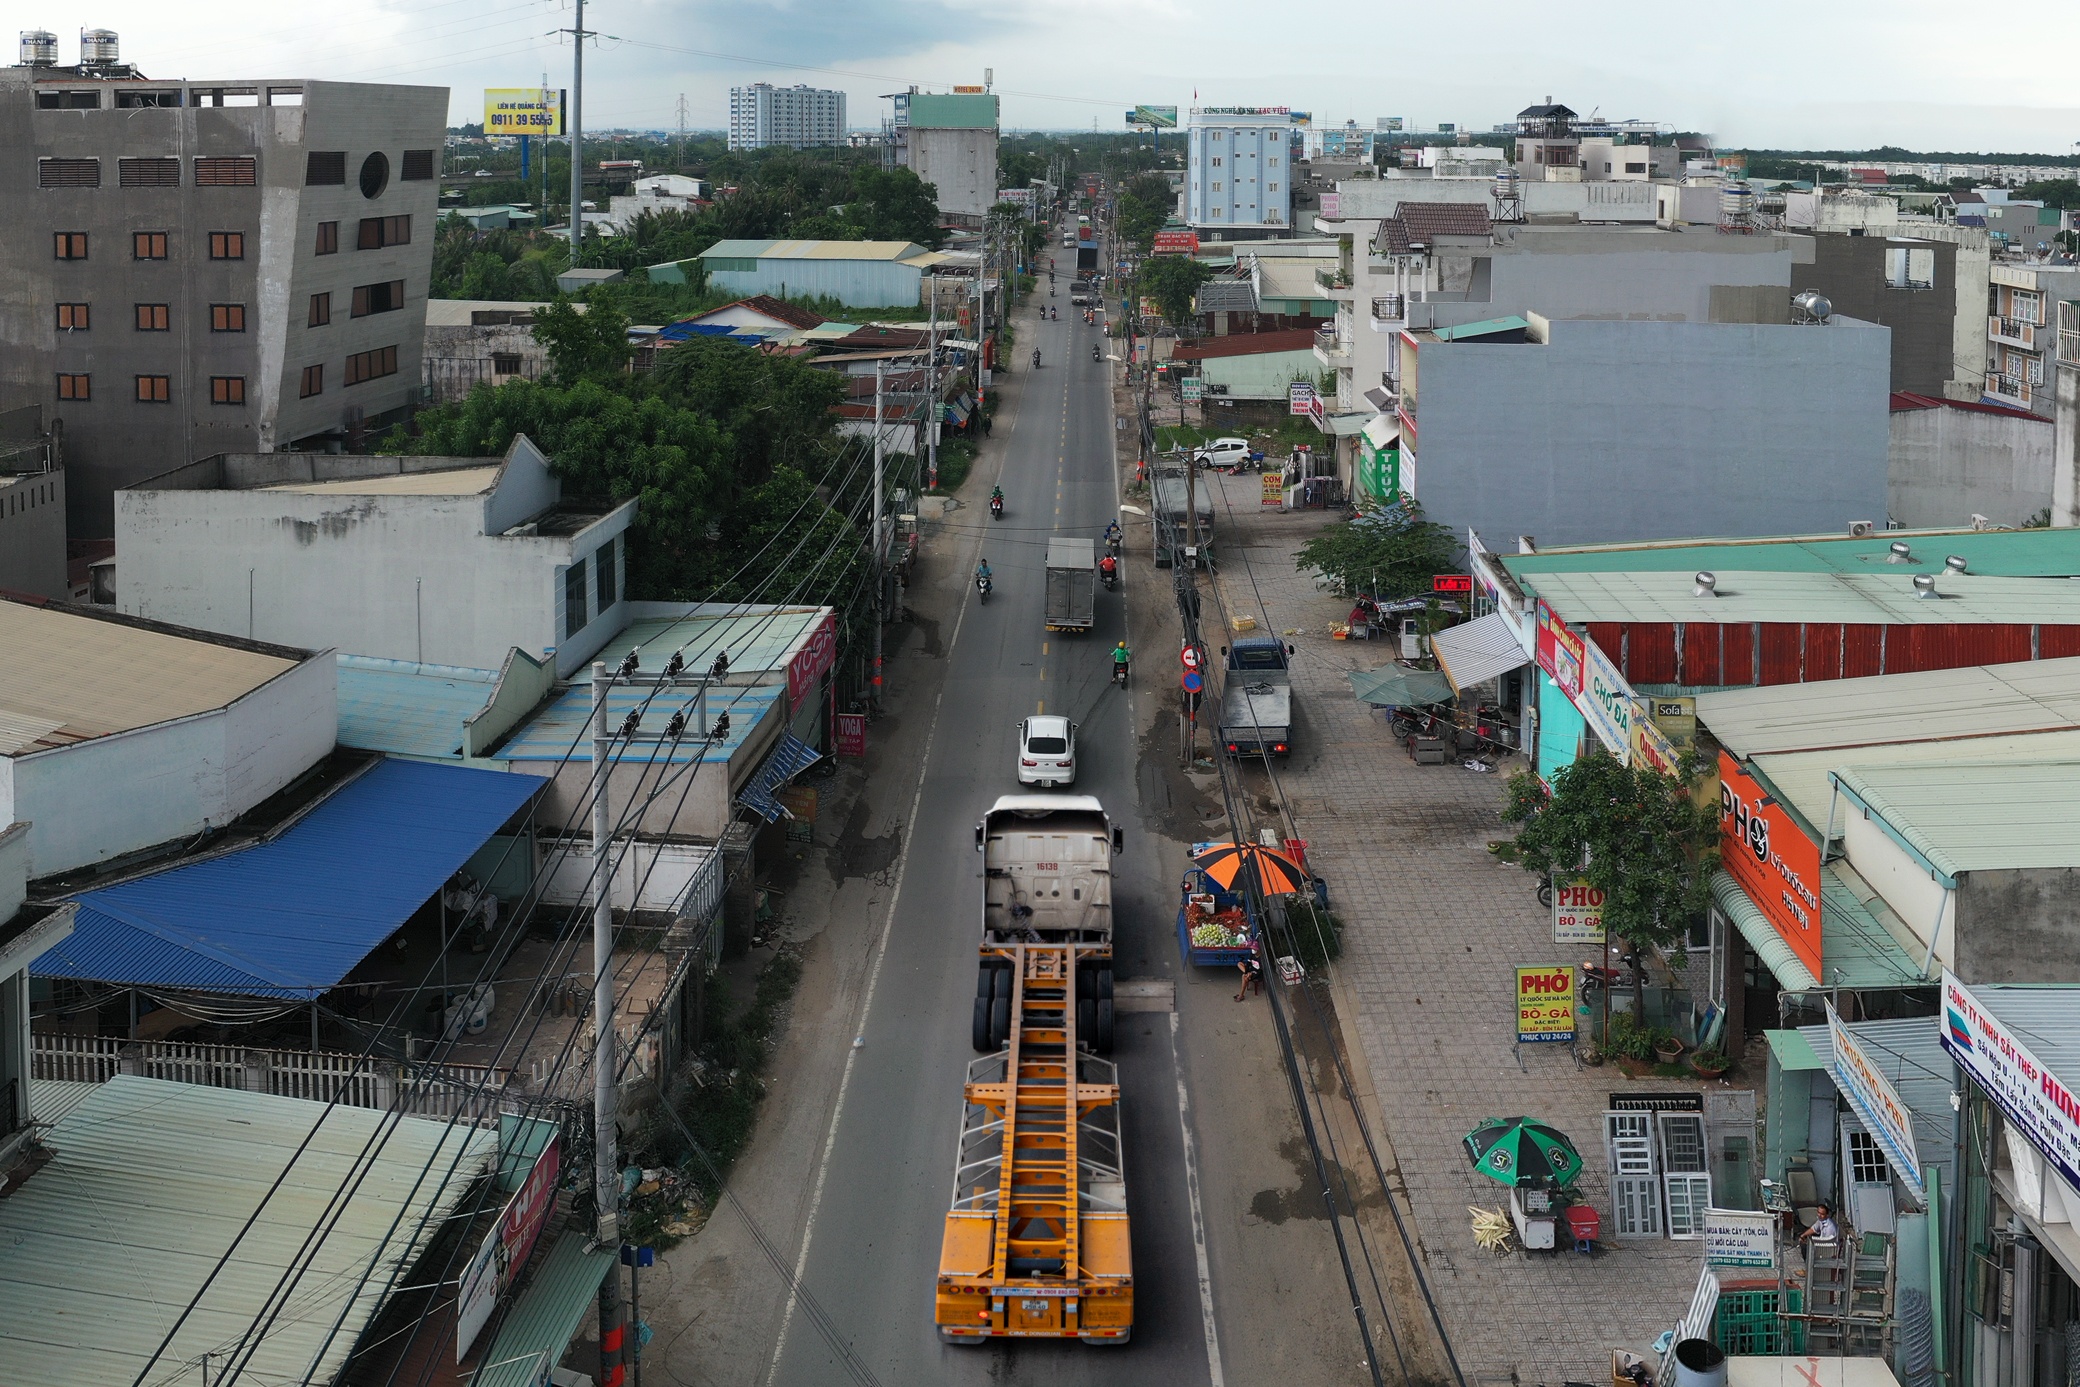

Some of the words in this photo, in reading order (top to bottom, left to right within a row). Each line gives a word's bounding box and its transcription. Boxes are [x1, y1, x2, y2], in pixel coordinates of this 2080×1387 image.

[518, 102, 534, 110] QUẢNG
[492, 114, 512, 125] 0911
[516, 114, 527, 125] 39
[793, 623, 832, 682] YOGA
[1660, 705, 1680, 715] Sofa
[1614, 703, 1628, 734] ĐÁ
[840, 718, 861, 736] YOGA
[1720, 779, 1769, 862] PHỞ
[1559, 914, 1575, 925] BÒ
[1585, 915, 1601, 926] GÀ
[1521, 968, 1569, 994] PHỞ
[1521, 1008, 1541, 1019] BÒ
[1549, 1006, 1570, 1018] GÀ
[1948, 984, 1966, 1014] CÔNG
[1969, 1004, 1977, 1024] TY
[1979, 1015, 1998, 1047] TNHH
[2000, 1038, 2016, 1062] SẮT
[2017, 1052, 2037, 1083] THÉP
[2002, 1064, 2008, 1076] U
[2032, 1094, 2045, 1116] Tôn
[2046, 1108, 2064, 1135] Lạnh
[1991, 1069, 2005, 1092] Tấm
[2006, 1085, 2017, 1106] Lấy
[2019, 1099, 2038, 1128] Sáng,
[2040, 1120, 2055, 1145] Poly
[2056, 1137, 2070, 1158] Đặc
[1494, 1155, 1507, 1167] ST
[1732, 1227, 1742, 1235] CÂY
[1758, 1226, 1768, 1236] CỬA
[1726, 1237, 1736, 1246] CÁC
